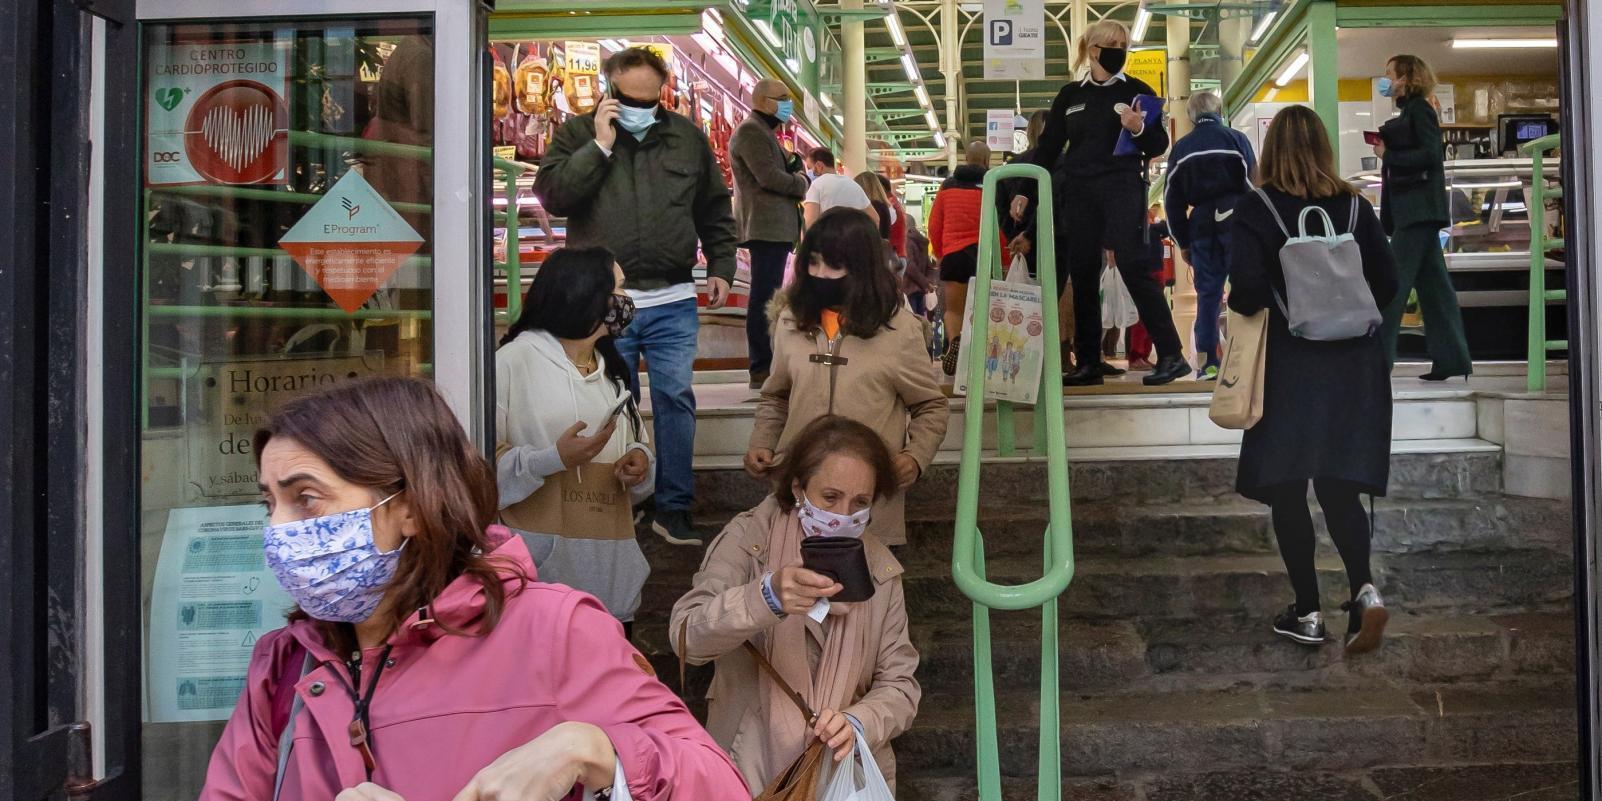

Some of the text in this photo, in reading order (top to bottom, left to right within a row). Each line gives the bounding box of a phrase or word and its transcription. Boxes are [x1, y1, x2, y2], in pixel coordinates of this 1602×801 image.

[993, 21, 1010, 44] P
[190, 48, 246, 61] CENTRO
[155, 62, 278, 76] CARDIOPROTEGIDO
[153, 151, 181, 163] DOC
[229, 368, 335, 393] Horario
[224, 414, 241, 426] De
[219, 432, 250, 456] de
[222, 469, 259, 485] sábad
